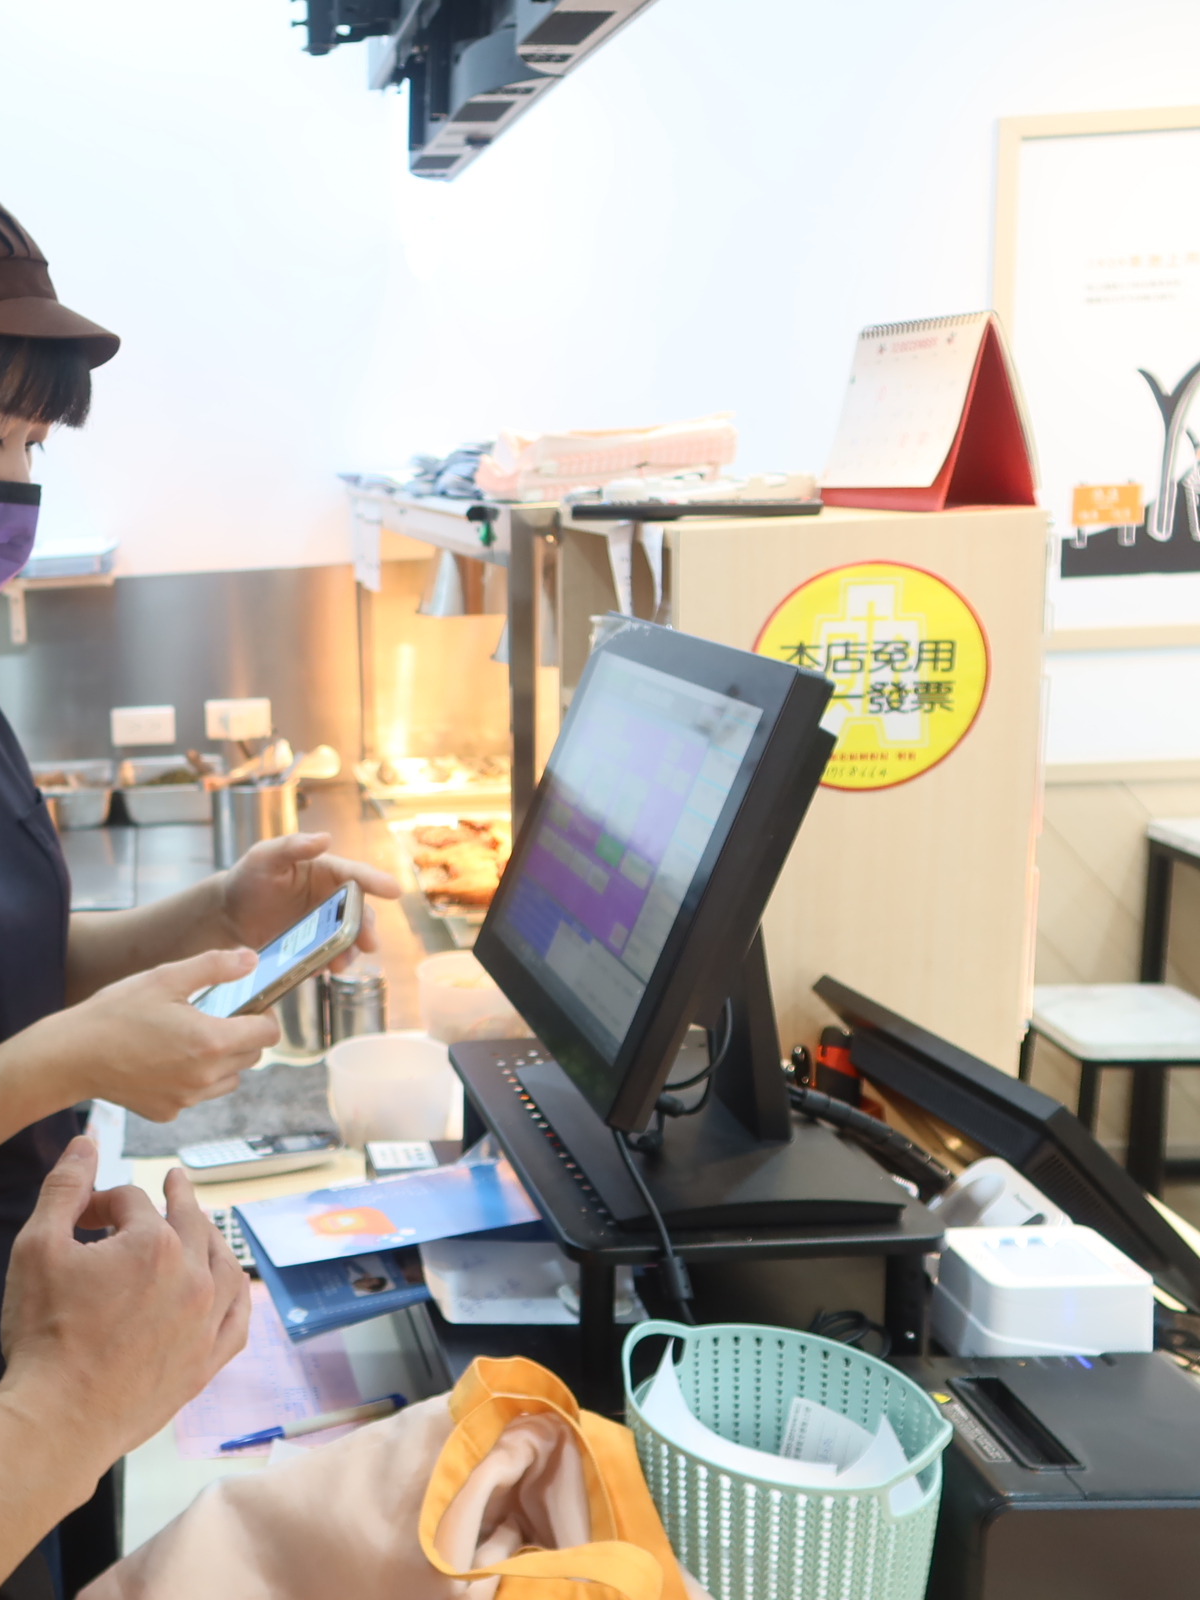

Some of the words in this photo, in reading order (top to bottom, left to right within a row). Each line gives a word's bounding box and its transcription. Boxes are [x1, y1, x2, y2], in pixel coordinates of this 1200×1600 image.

[781, 640, 957, 674] 本店免用
[831, 680, 956, 714] 一發票
